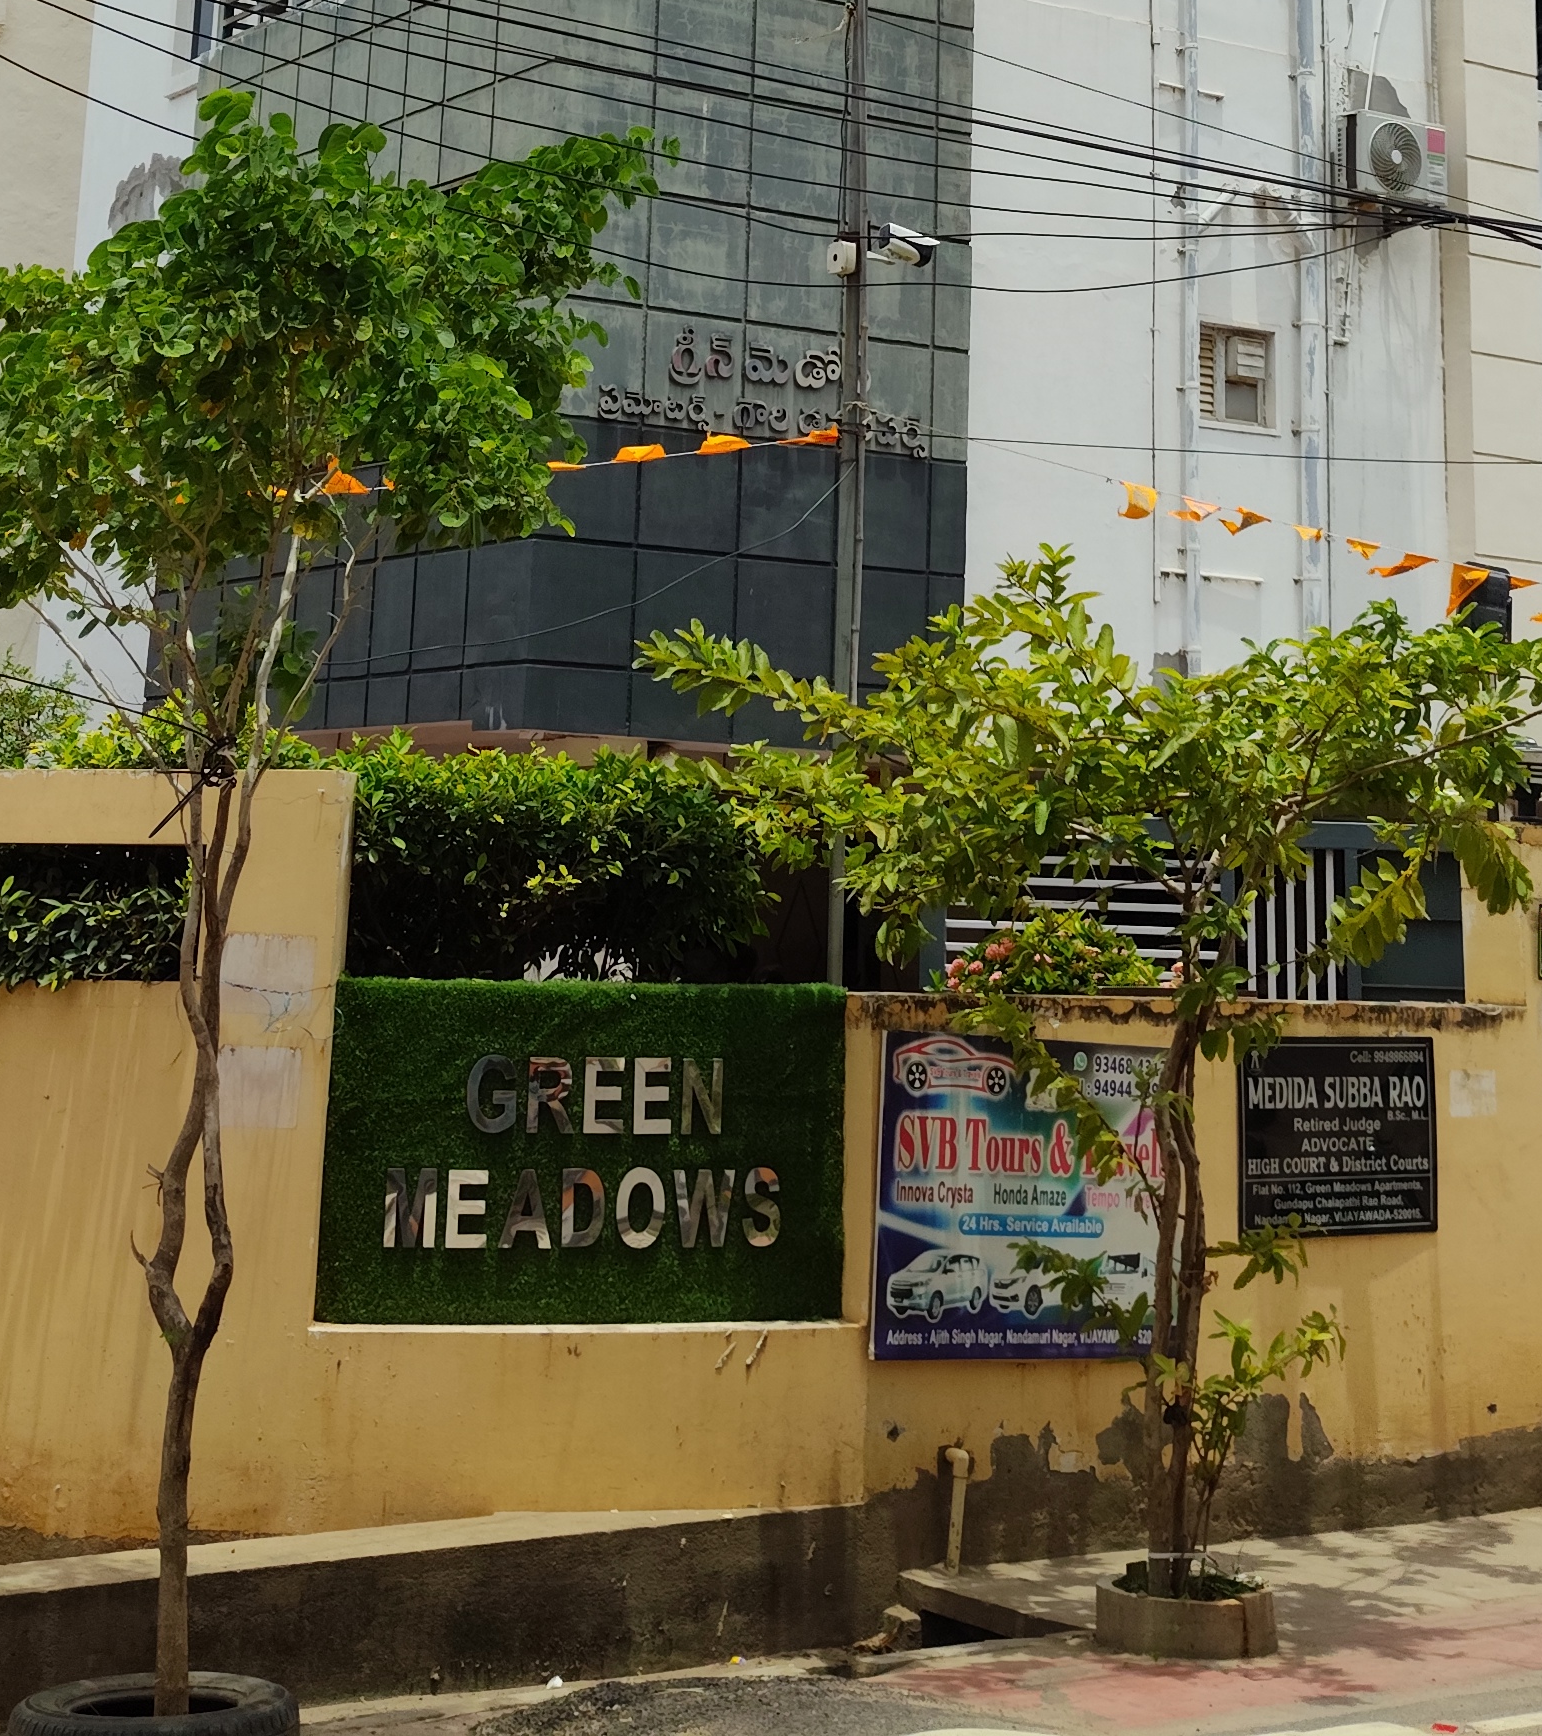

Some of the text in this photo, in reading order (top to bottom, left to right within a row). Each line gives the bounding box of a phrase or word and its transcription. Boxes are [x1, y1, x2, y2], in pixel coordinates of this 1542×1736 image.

[467, 1054, 723, 1134] GREEN
[1094, 1079, 1132, 1097] 94944
[1248, 1075, 1425, 1110] MEDIDA SUBBA RAO
[1294, 1117, 1381, 1134] Retired Judge
[899, 1114, 957, 1170] SVB
[965, 1118, 1042, 1174] Tours
[1049, 1122, 1073, 1175] &
[1301, 1137, 1375, 1152] ADVOCATE
[1248, 1155, 1429, 1175] HIGH COURT & District Courts
[896, 1179, 934, 1202] Innova
[938, 1181, 973, 1209] Crysta
[993, 1183, 1028, 1205] Honda
[1031, 1185, 1067, 1207] Amaze
[1086, 1187, 1120, 1211] Tempo
[1252, 1185, 1269, 1195] Flat
[1271, 1184, 1285, 1195] No.
[1306, 1182, 1331, 1194] Green
[1333, 1181, 1371, 1193] Meadows
[1373, 1180, 1423, 1193] Apartments,
[382, 1167, 781, 1249] MEADOWS
[1315, 1196, 1360, 1209] Chalapathi
[1380, 1194, 1404, 1206] Road,
[962, 1216, 1103, 1234] 24 Hrs. Service Available
[1304, 1212, 1332, 1225] Nagar,
[886, 1329, 922, 1345] Address
[929, 1329, 950, 1348] Ajith
[952, 1329, 976, 1348] Singh
[978, 1329, 1004, 1348] Nagar,
[1006, 1329, 1050, 1344] Nandamuri
[1052, 1329, 1078, 1347] Nagar,
